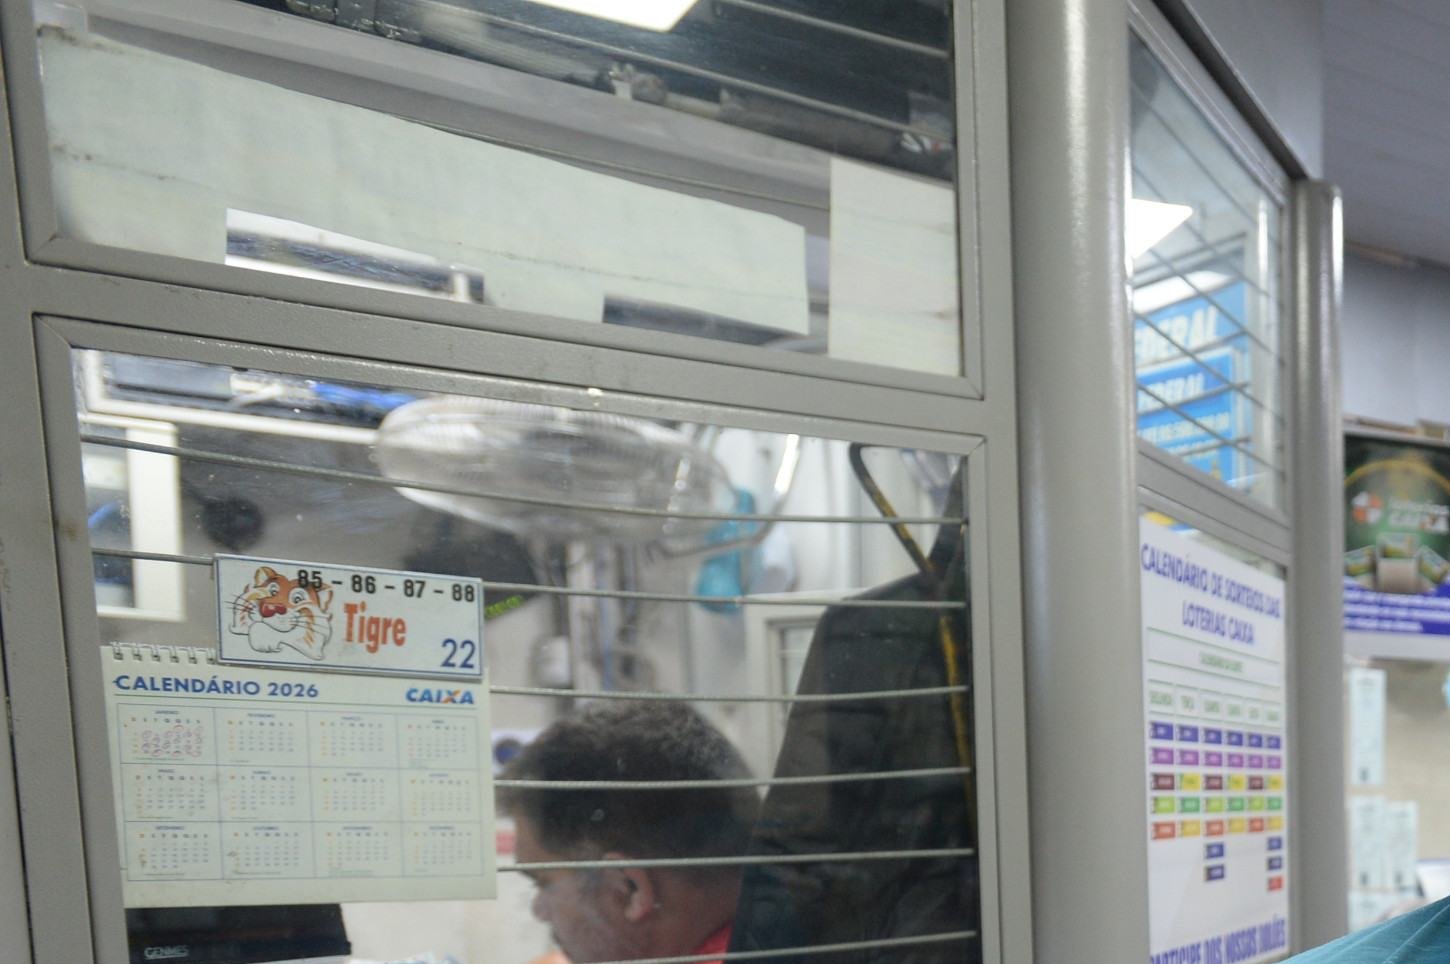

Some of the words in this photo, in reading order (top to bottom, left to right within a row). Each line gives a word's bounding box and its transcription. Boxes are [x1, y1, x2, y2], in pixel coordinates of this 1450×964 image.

[298, 569, 323, 590] 85
[352, 574, 376, 594] 86
[403, 579, 426, 598] 87
[452, 583, 475, 602] 88
[1141, 544, 1208, 592] CALENDÁRIO
[1211, 572, 1223, 597] DE
[343, 601, 406, 653] Tigre
[441, 638, 476, 669] 22
[114, 673, 261, 697] CALENDÁRIO
[267, 682, 319, 698] 2026
[405, 687, 475, 705] CAIXA
